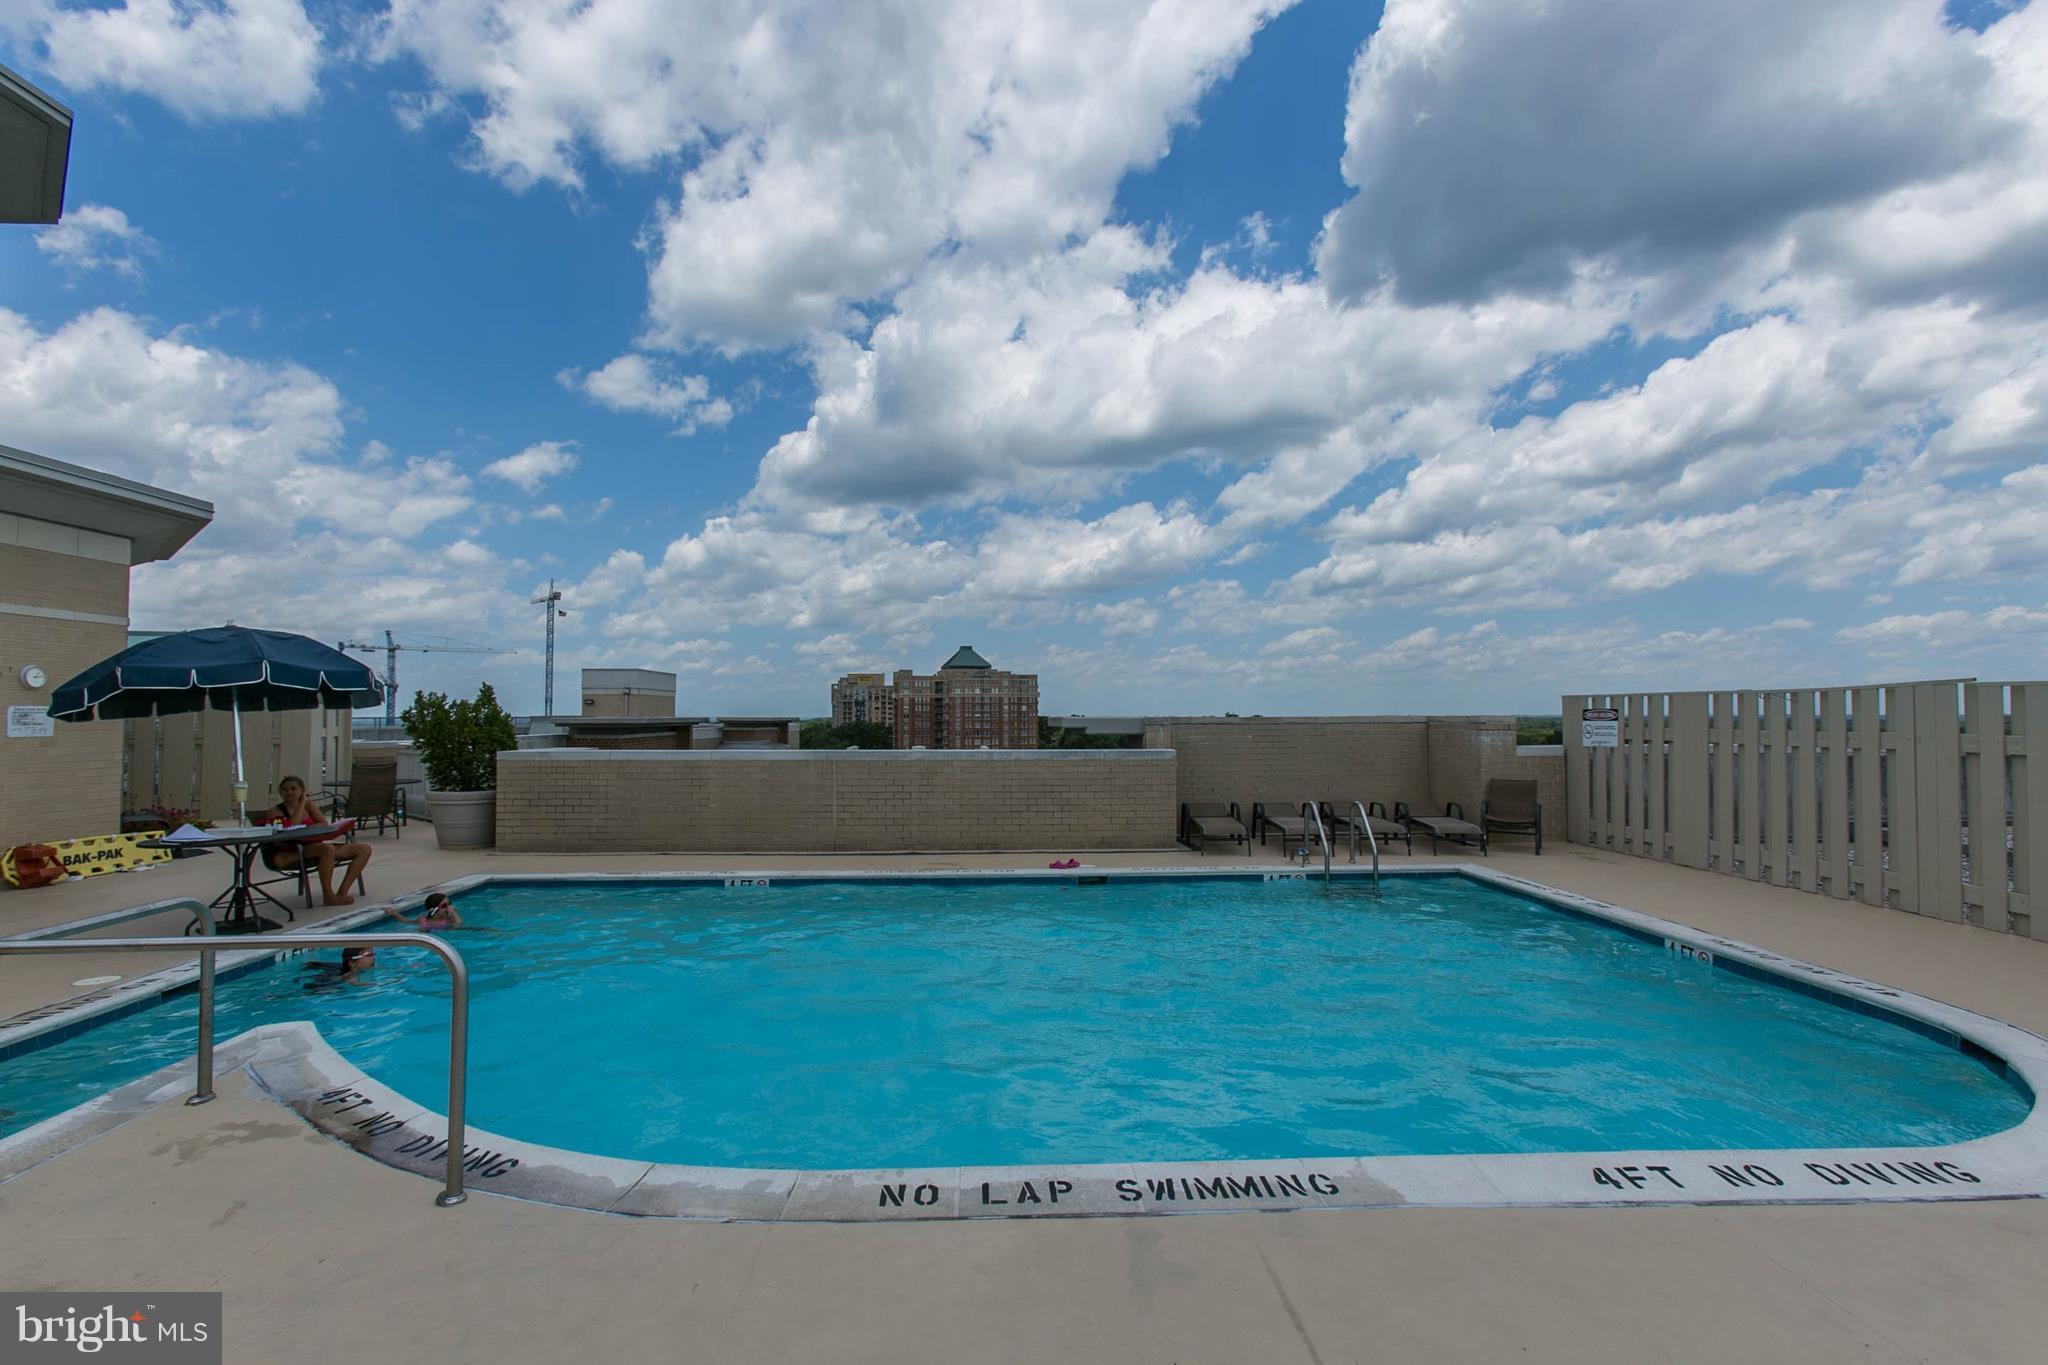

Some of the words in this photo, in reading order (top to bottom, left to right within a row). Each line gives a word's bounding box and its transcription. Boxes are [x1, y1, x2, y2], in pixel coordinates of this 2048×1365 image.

[63, 848, 124, 866] BAK-PAK
[317, 1088, 374, 1114] 4FT
[353, 1111, 405, 1136] NO
[879, 1184, 939, 1207] NO
[981, 1180, 1073, 1205] LAP
[1115, 1173, 1340, 1201] SWIMMING
[1593, 1165, 1685, 1190] 4FT
[1708, 1164, 1785, 1187] NO
[1803, 1161, 1981, 1185] DIVING
